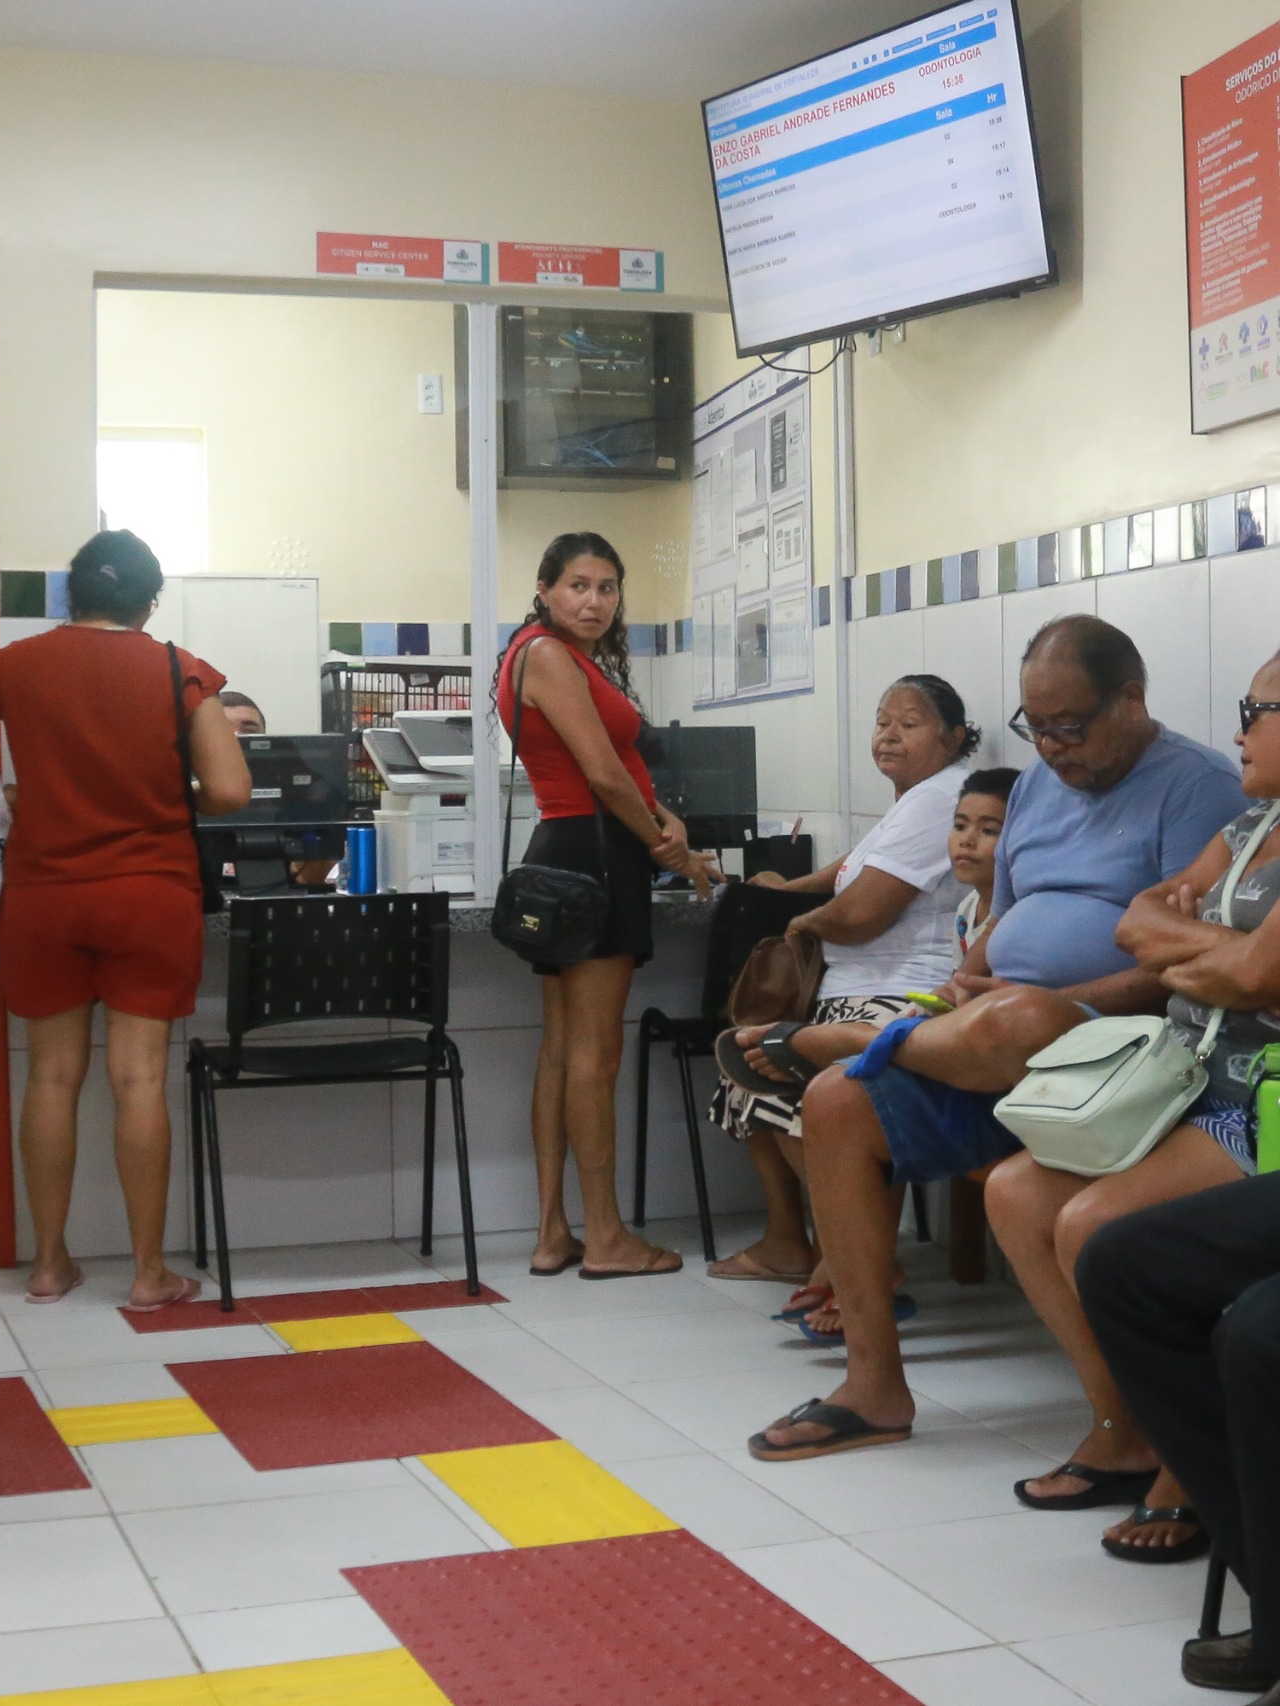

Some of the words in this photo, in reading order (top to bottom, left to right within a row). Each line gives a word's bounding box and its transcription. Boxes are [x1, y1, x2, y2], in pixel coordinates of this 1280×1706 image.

[939, 41, 956, 54] Sala
[918, 47, 982, 77] ODONTOLOGIA
[1225, 59, 1263, 92] SERVIÇOS
[1264, 51, 1277, 69] DO
[774, 82, 782, 92] DE
[784, 68, 819, 88] FORTALEZA
[942, 75, 964, 89] 15:38
[1235, 74, 1271, 104] ODORICO
[935, 108, 953, 121] Sala
[987, 92, 997, 104] Hr
[713, 139, 738, 157] ENZO
[740, 125, 781, 147] GABRIEL
[783, 104, 831, 132] ANDRADE
[833, 82, 896, 113] FERNANDES
[716, 157, 729, 170] DA
[730, 145, 761, 164] COSTA
[938, 202, 977, 218] ODONTOLOGIA
[331, 248, 362, 257] CITIZEN
[363, 250, 396, 259] SERVICE
[397, 252, 429, 260] CENTER
[372, 240, 389, 249] NAC
